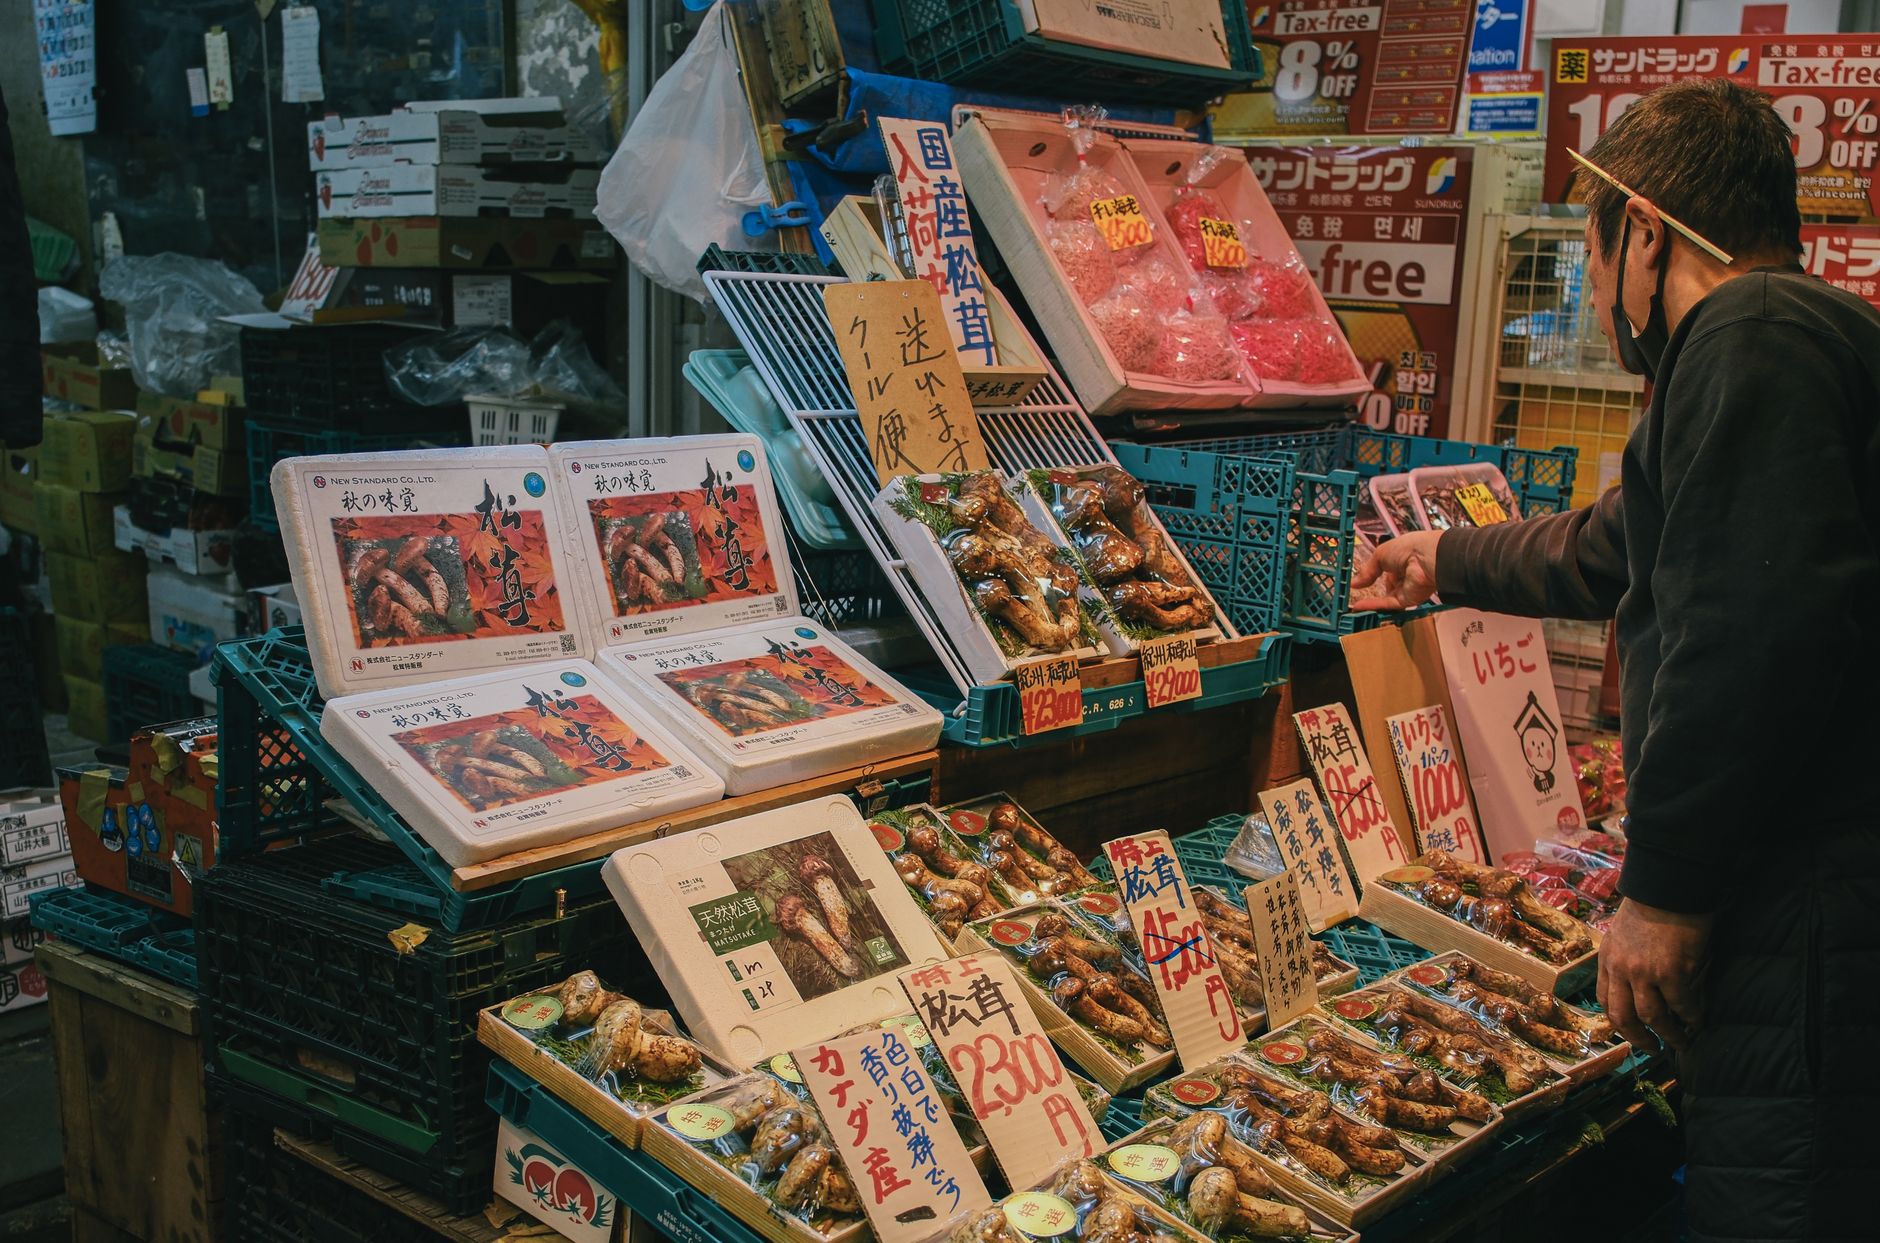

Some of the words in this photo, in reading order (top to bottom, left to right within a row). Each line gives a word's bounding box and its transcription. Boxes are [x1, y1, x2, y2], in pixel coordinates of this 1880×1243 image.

[1283, 10, 1370, 33] Tax-free
[1326, 40, 1359, 70] %
[1559, 51, 1587, 81] 薬
[1592, 47, 1720, 73] サンドラッグ
[1275, 39, 1322, 102] 8
[1770, 59, 1880, 85] Tax-free
[1321, 74, 1357, 98] OFF
[1833, 98, 1879, 135] %
[1829, 140, 1879, 168] OFF
[1250, 155, 1416, 192] サンドラッグ
[1414, 198, 1463, 210] SUNDRUG
[912, 126, 998, 366] 国産松茸
[850, 315, 925, 474] クール便
[895, 306, 970, 471] 送れます
[1396, 372, 1437, 395] 할인
[1396, 395, 1414, 411] Up
[1417, 395, 1432, 411] to
[1394, 414, 1430, 436] OFF
[585, 462, 601, 471] NEW
[601, 458, 638, 469] STANDARD
[331, 477, 351, 485] NEW
[352, 476, 399, 485] STANDARD
[594, 468, 656, 494] 秋の味覚
[341, 487, 419, 512] 秋の味覚
[622, 615, 684, 631] 株式会社ニュースタンダード
[366, 650, 445, 665] 株式会社ニュースタンダード
[655, 651, 722, 669] 秋の味覚
[1472, 632, 1538, 686] いちご
[372, 703, 394, 715] NEW
[394, 698, 440, 712] STANDARD
[392, 703, 472, 728] 秋の味覚
[1082, 705, 1104, 715] C.R.
[1108, 698, 1125, 710] 626
[1299, 708, 1342, 732] 特上
[1401, 705, 1445, 751] いちご
[1308, 723, 1360, 768] 松茸
[1420, 747, 1449, 768] 1パック
[1412, 760, 1465, 831] 1,000
[1109, 837, 1165, 867] 特上
[1294, 788, 1343, 897] 松茸焼き
[1379, 825, 1409, 865] 円
[1454, 816, 1479, 865] 円
[1120, 853, 1186, 909] 松茸
[698, 896, 761, 928] 天然松茸
[709, 924, 736, 939] まつたけ
[713, 928, 757, 948] MATSUTAKE
[910, 958, 985, 989] 特上
[513, 1001, 556, 1022] 特選
[918, 973, 1022, 1037] 松茸
[1205, 974, 1240, 1043] 円
[882, 1032, 939, 1124] 色白で
[948, 1032, 1063, 1121] 2,300
[680, 1109, 726, 1132] 特選
[810, 1045, 912, 1205] カナダ産
[860, 1045, 961, 1214] 香り抜群です
[1041, 1092, 1094, 1158] 円
[1123, 1152, 1170, 1173] 特選
[1017, 1200, 1067, 1228] 特選
